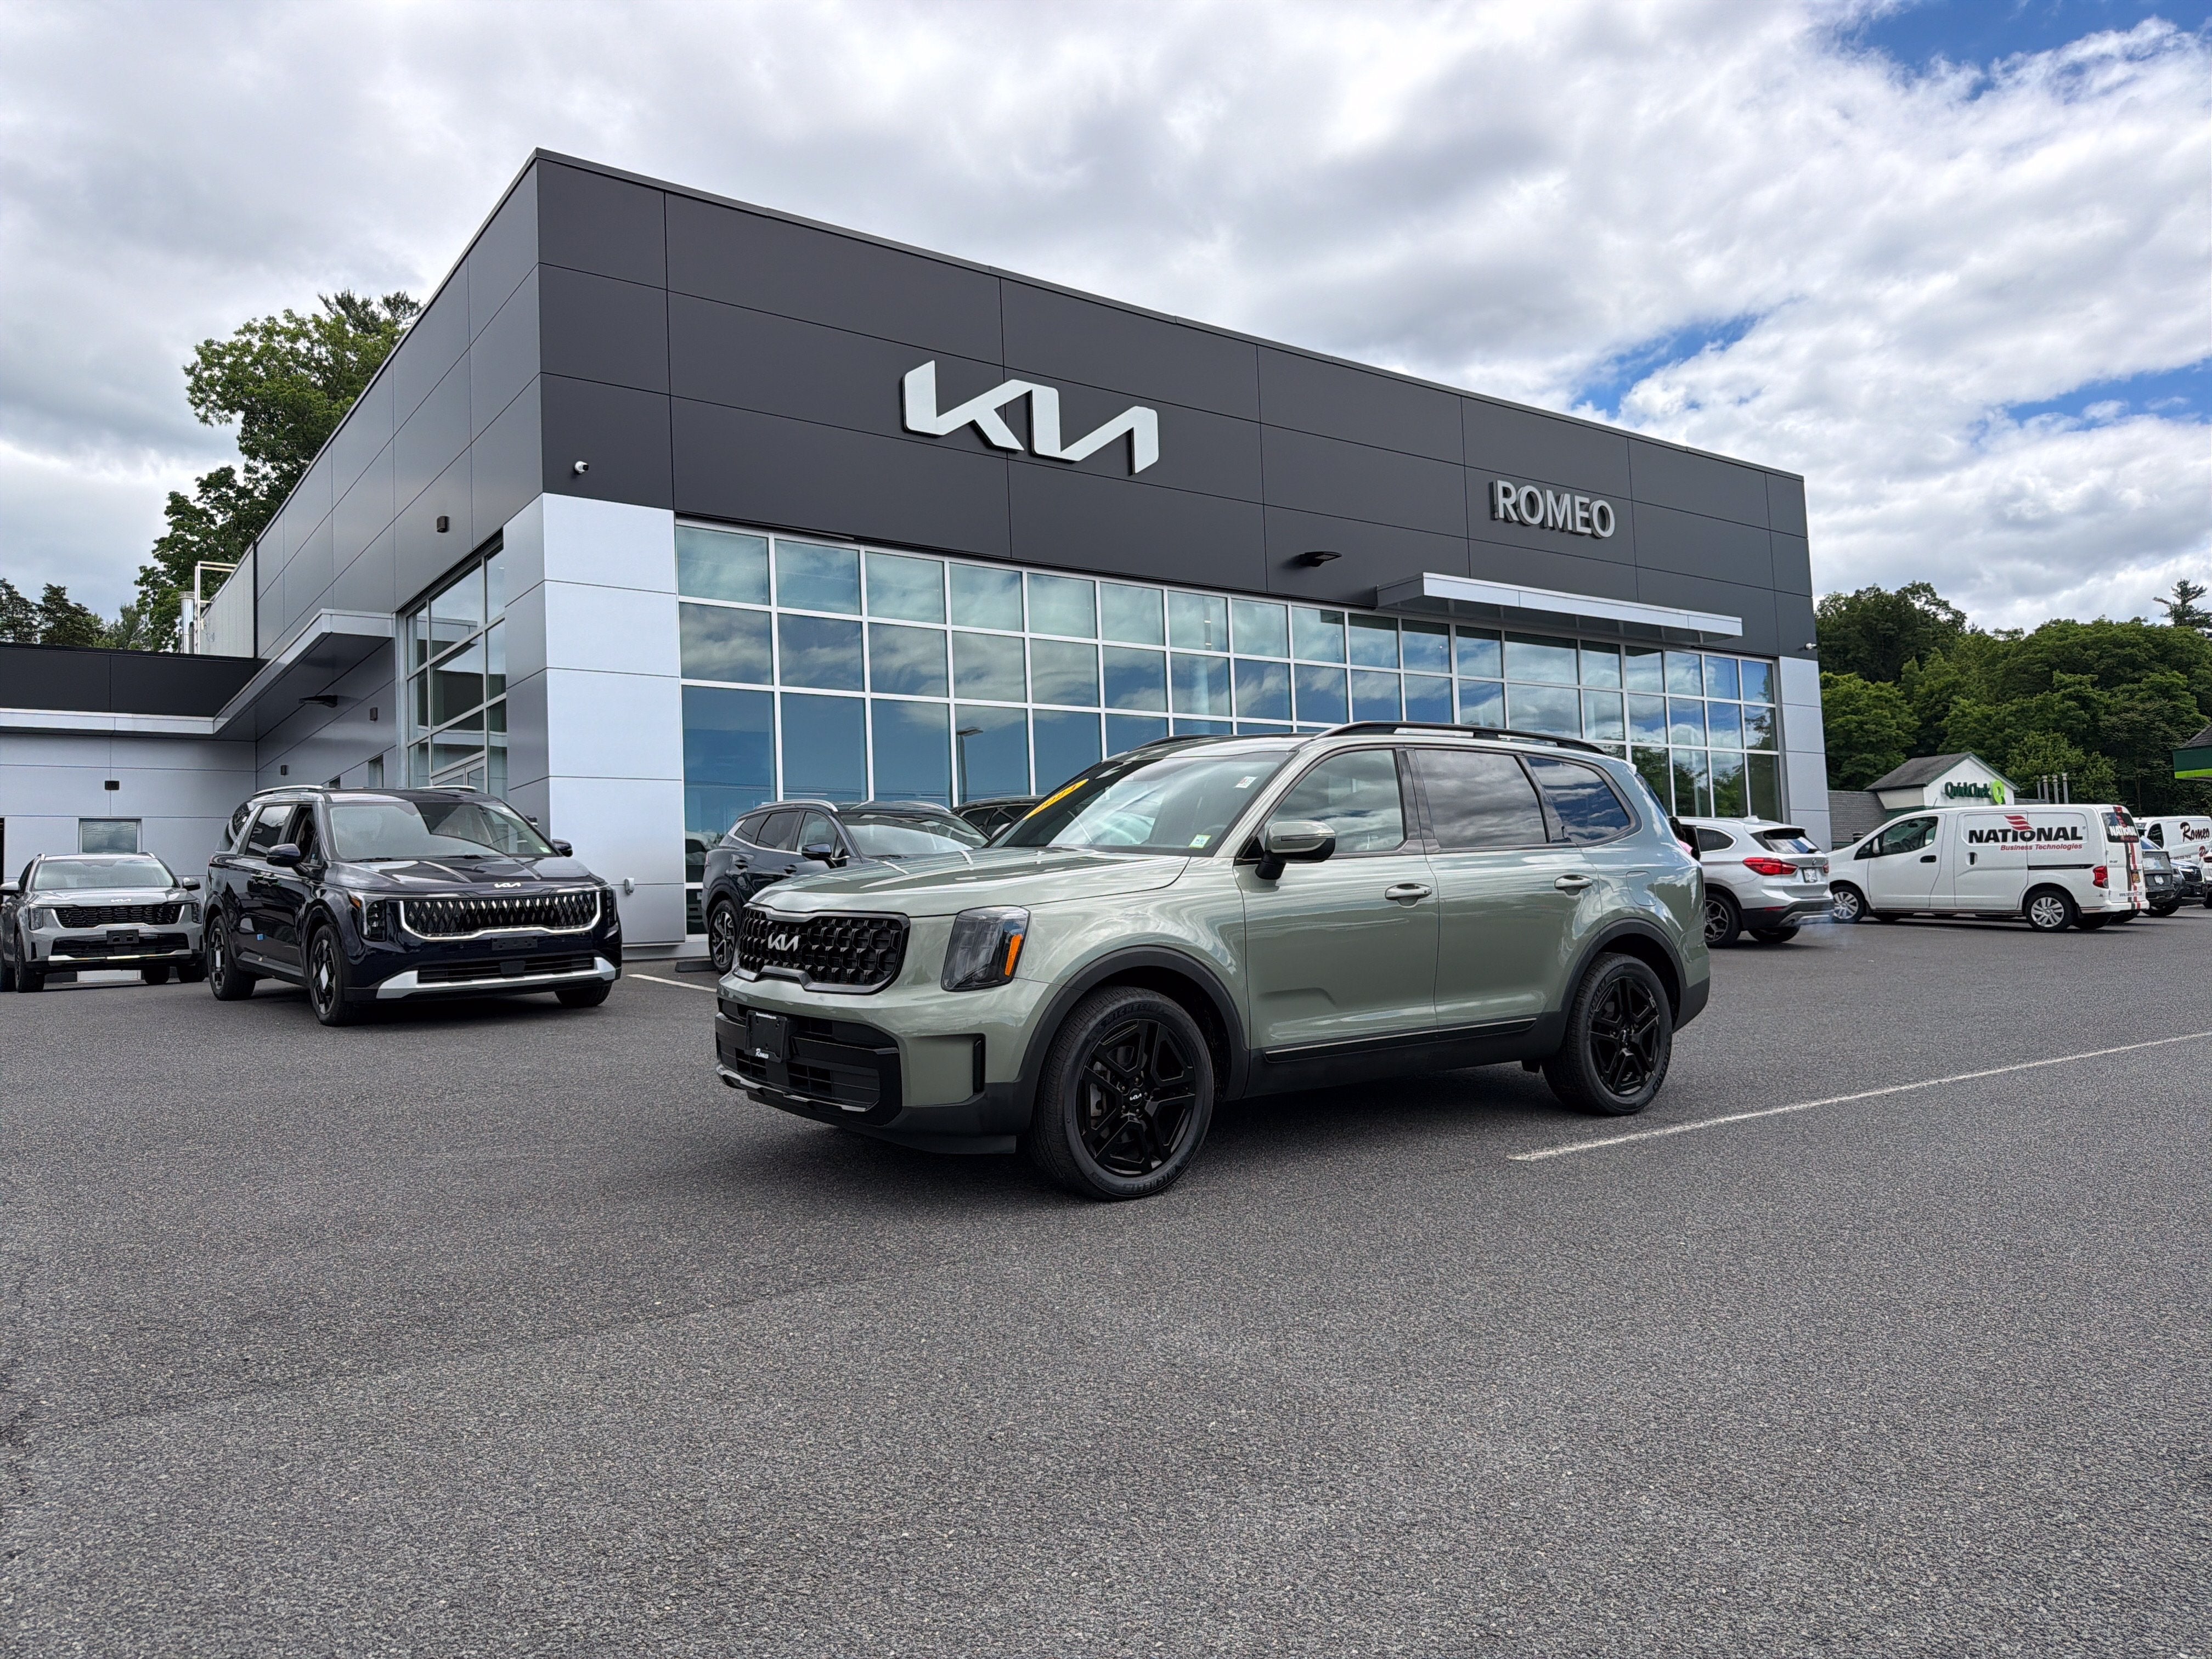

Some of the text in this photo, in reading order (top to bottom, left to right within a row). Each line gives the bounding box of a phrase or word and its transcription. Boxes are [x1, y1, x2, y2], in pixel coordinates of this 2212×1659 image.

[904, 360, 1159, 475] KIA
[1493, 479, 1615, 538] ROMEO
[1968, 827, 2083, 843] NATIONAL
[2180, 822, 2210, 843] Romeo
[768, 932, 799, 952] KIA
